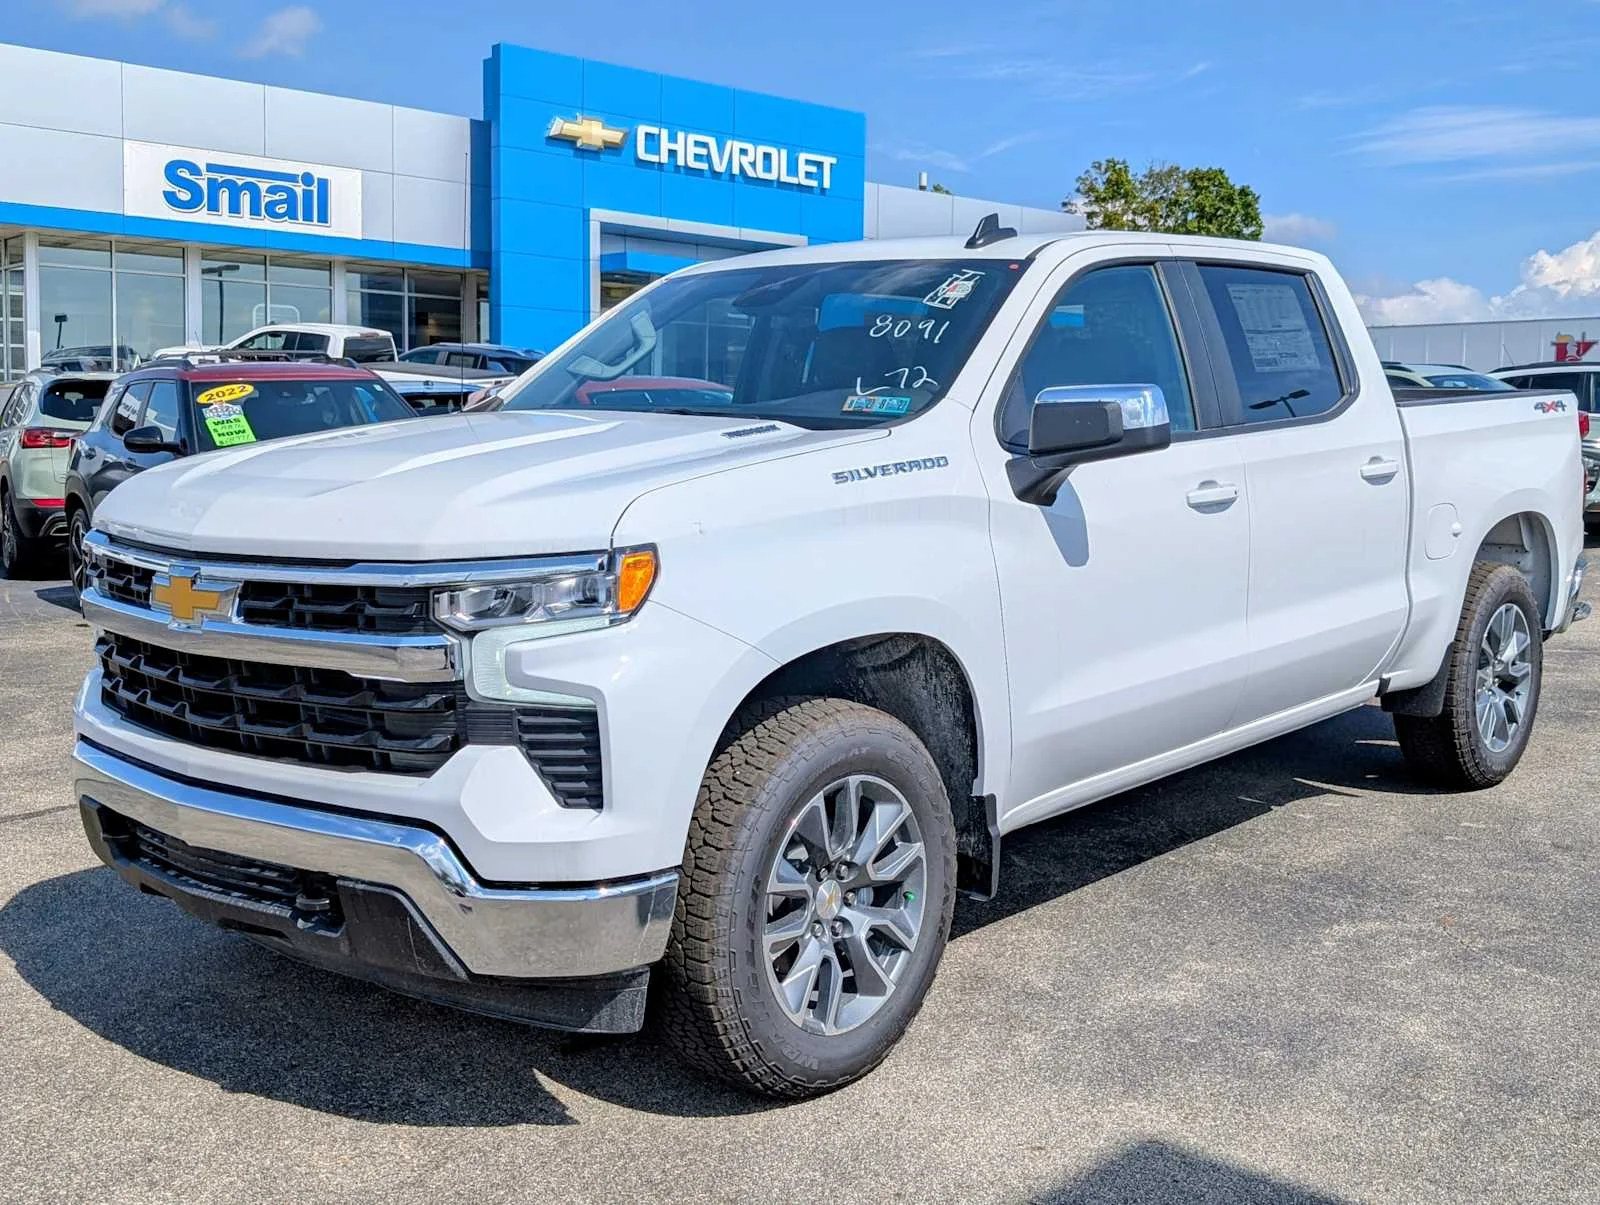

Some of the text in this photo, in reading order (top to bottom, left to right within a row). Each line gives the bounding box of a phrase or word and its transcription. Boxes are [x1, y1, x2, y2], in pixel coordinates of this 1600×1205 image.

[636, 124, 837, 189] CHEVROLET
[162, 159, 330, 224] Smail
[869, 314, 950, 344] 8091
[204, 385, 248, 402] 2022
[212, 417, 241, 426] WAS
[217, 429, 246, 438] NOW
[831, 456, 949, 484] SILVERADO
